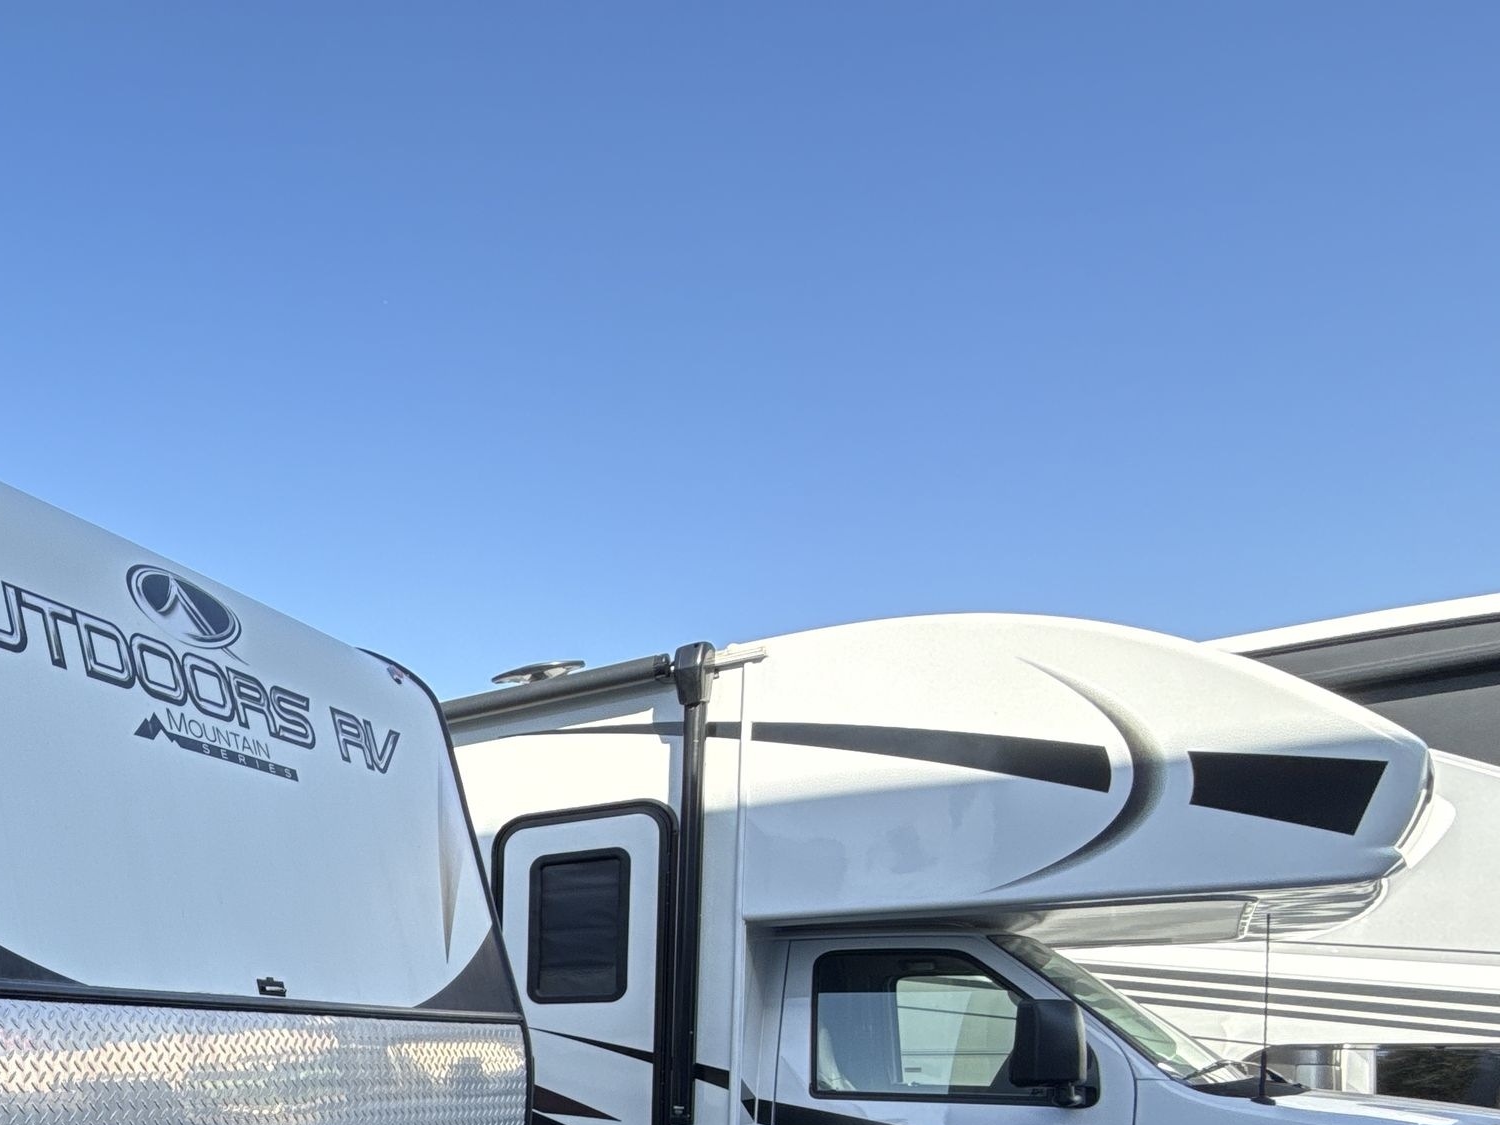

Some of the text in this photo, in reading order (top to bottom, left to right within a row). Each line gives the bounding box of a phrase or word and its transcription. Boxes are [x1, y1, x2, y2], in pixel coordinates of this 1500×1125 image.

[166, 707, 271, 760] MOUNTAIN
[329, 706, 400, 775] RV
[201, 743, 294, 779] SERIES
